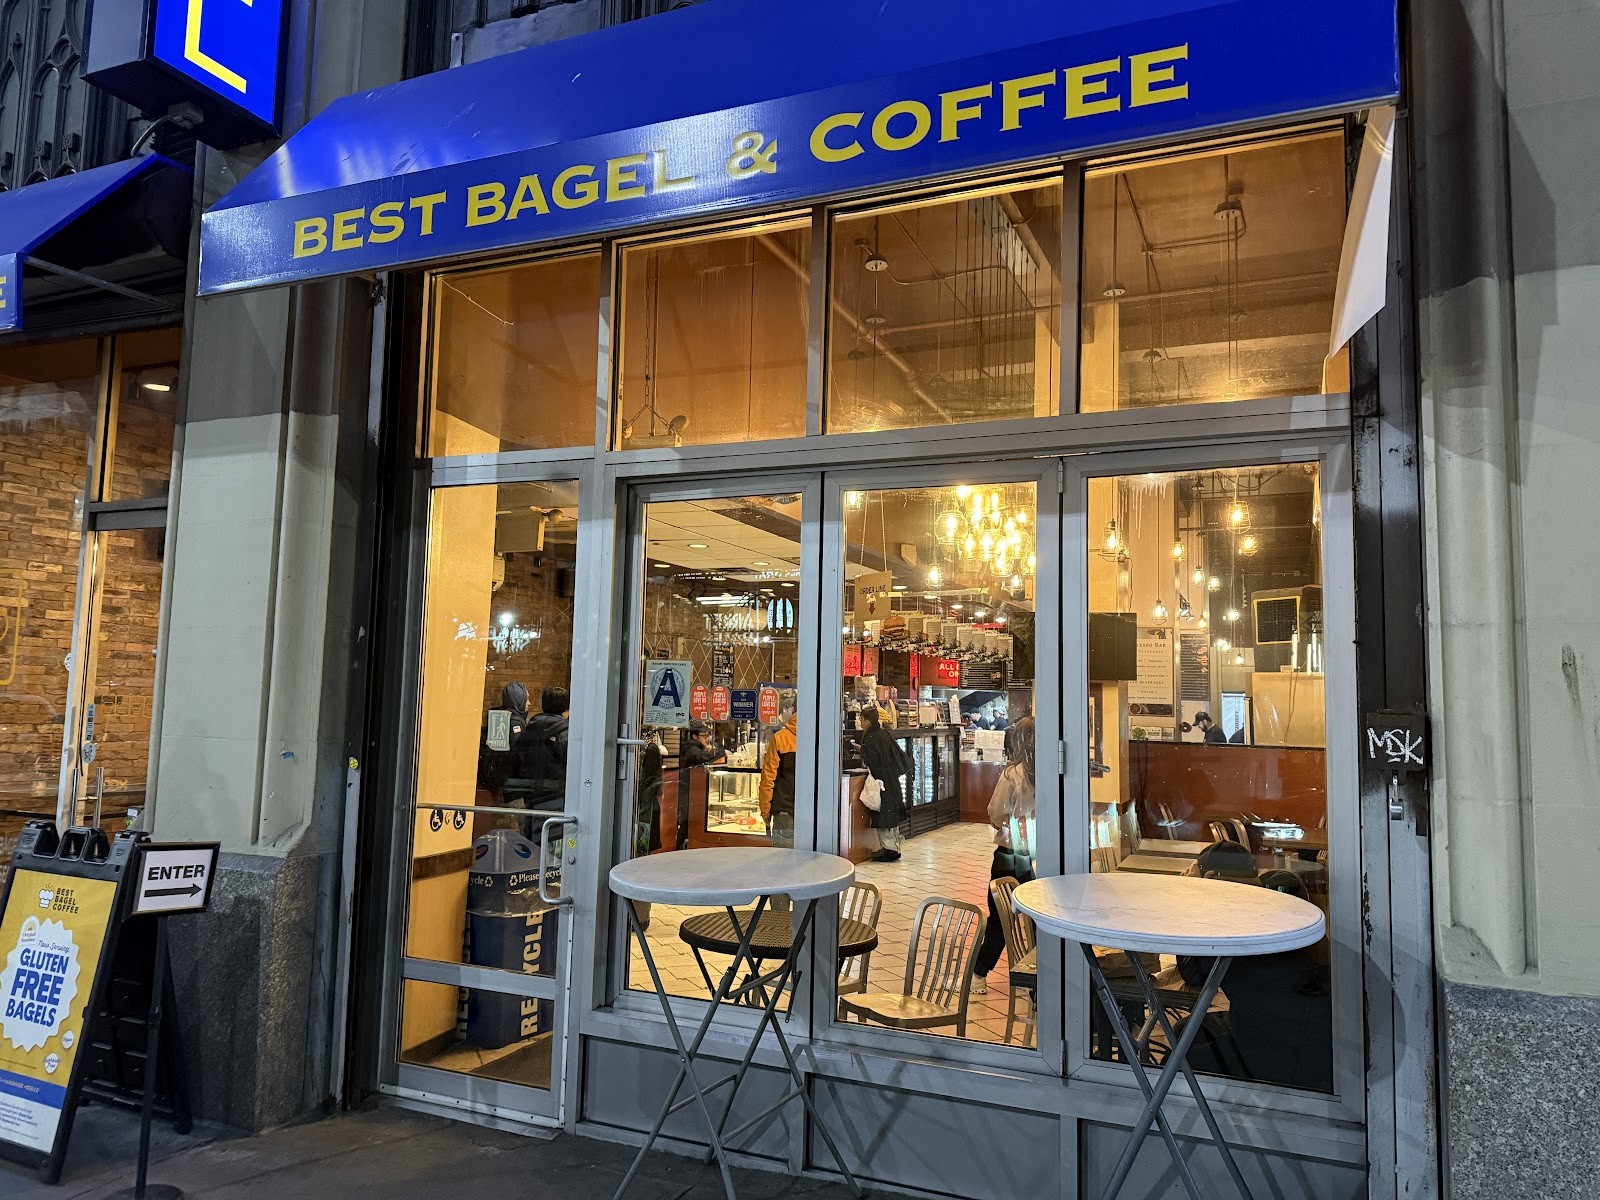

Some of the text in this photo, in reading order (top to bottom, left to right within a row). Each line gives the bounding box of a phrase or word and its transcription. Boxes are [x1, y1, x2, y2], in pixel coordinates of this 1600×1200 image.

[292, 41, 1190, 259] BEST BAGEL & COFFEE
[860, 584, 886, 595] ORDER LINE
[652, 669, 682, 707] A
[147, 864, 206, 881] ENTER
[518, 869, 562, 883] Please ecycl
[54, 896, 76, 906] BAGEL
[56, 888, 75, 897] BEST
[52, 903, 79, 914] COFFEE
[49, 942, 71, 954] Serving
[20, 947, 70, 974] GLUTEN
[521, 911, 544, 1037] REYCLE
[10, 968, 65, 1006] FREE
[5, 998, 57, 1027] BAGELS
